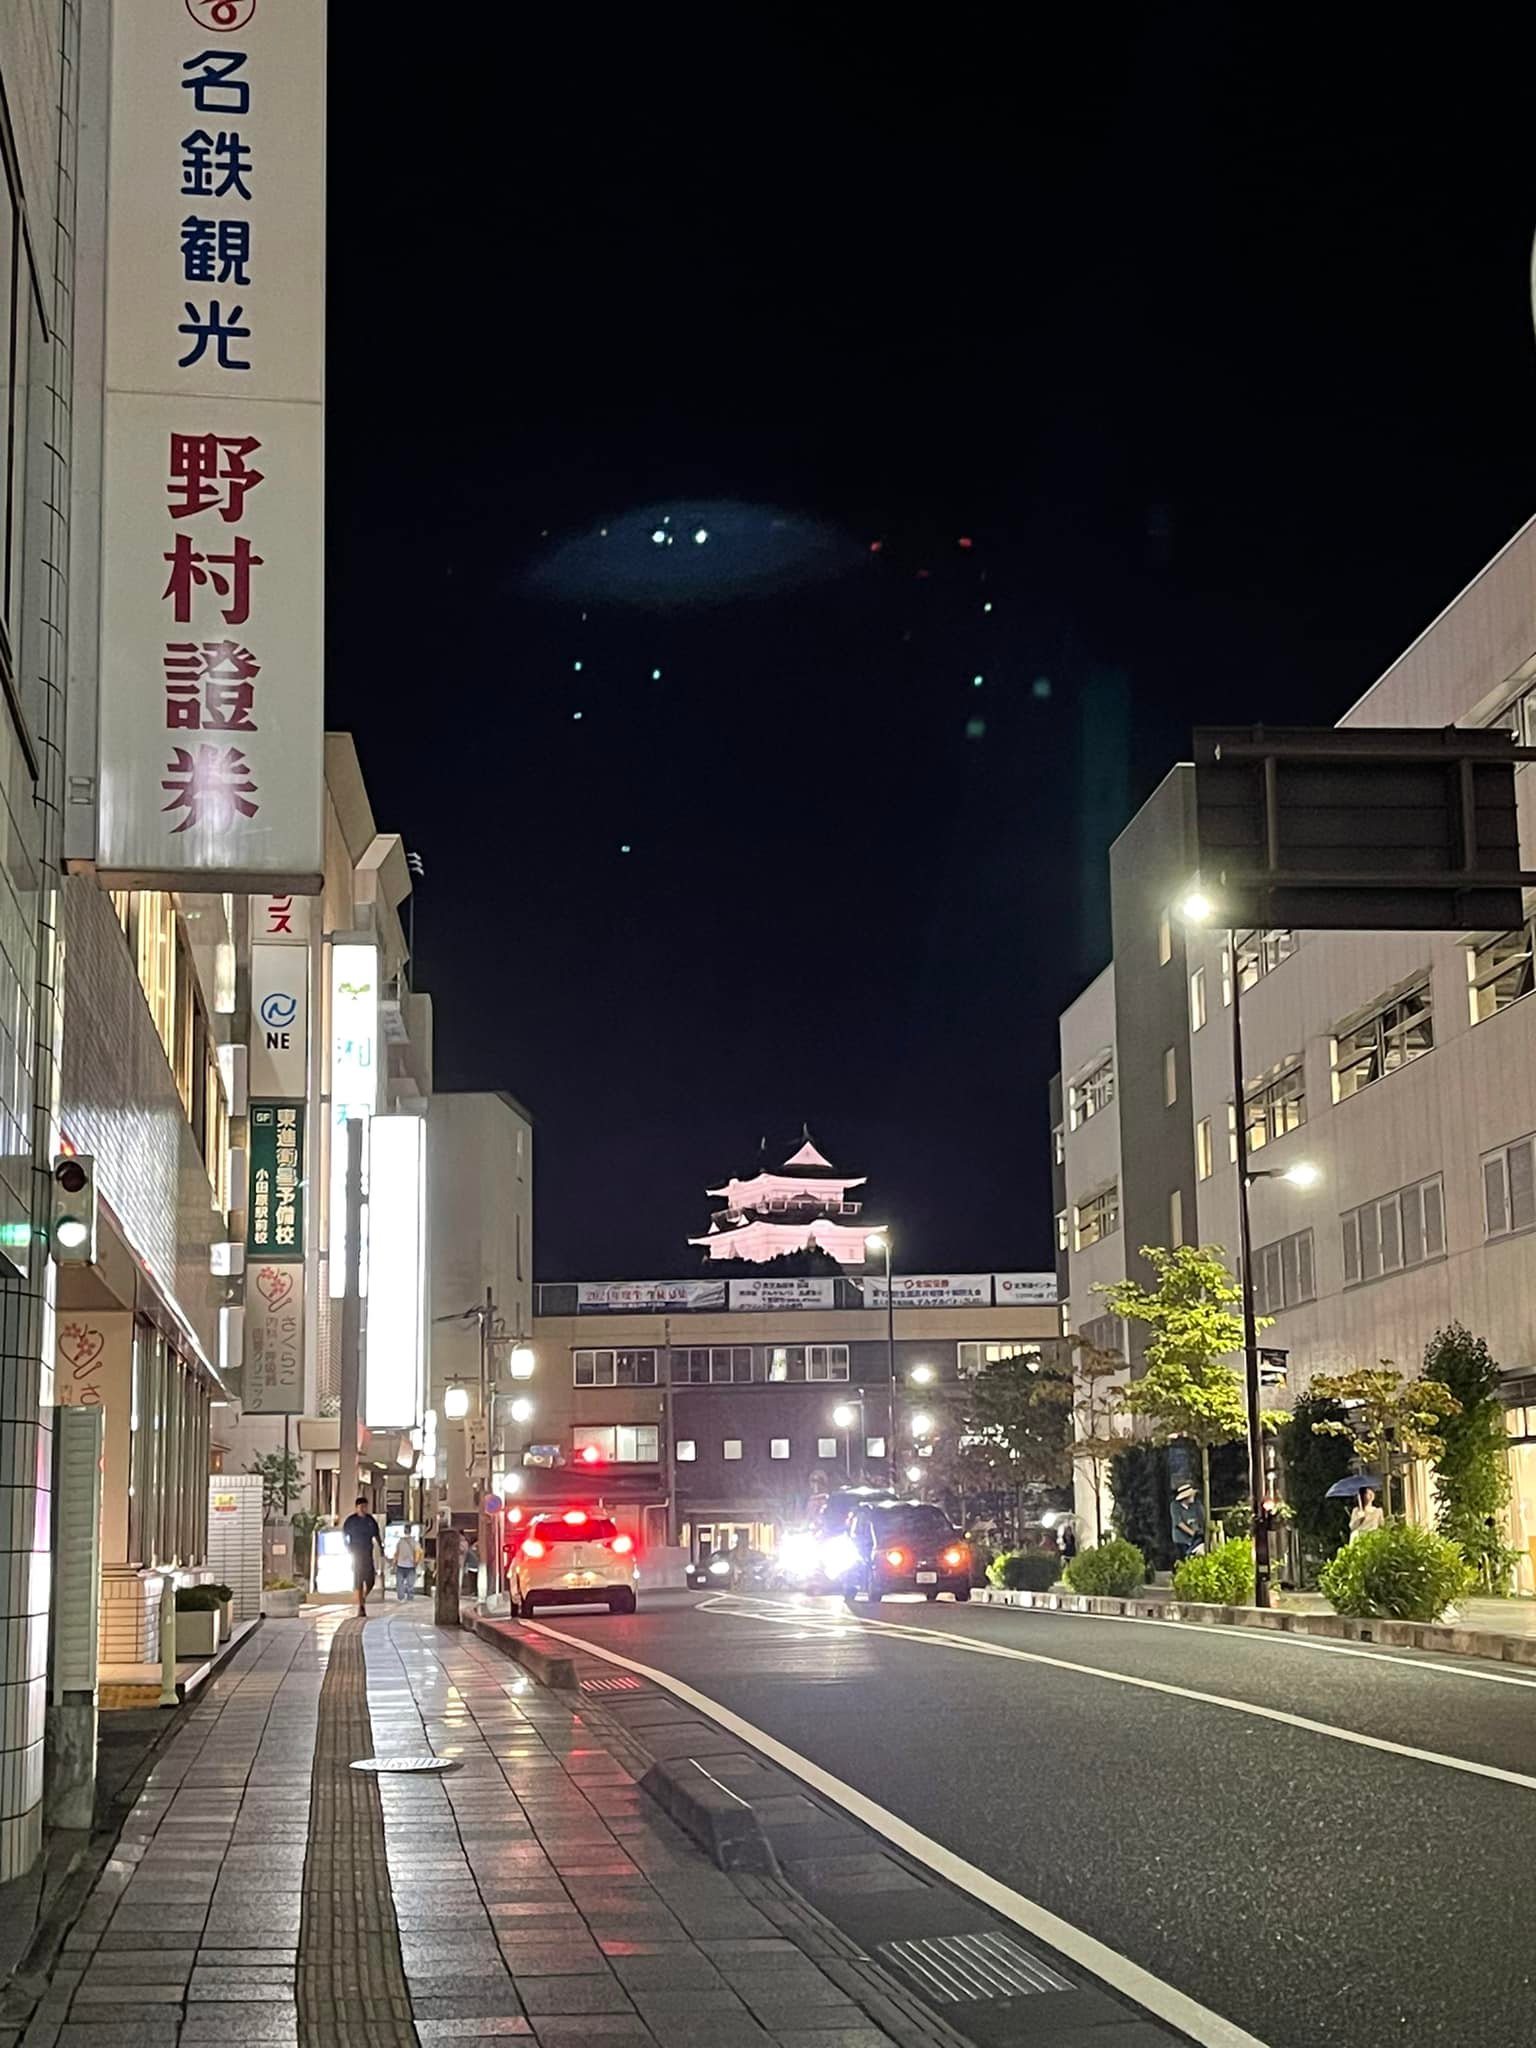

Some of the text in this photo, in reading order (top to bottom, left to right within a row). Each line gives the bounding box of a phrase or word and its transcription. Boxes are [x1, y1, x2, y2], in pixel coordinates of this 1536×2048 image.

[178, 50, 253, 370] 名鉄観光
[267, 1032, 290, 1049] NE
[255, 1168, 269, 1244] 小田原駅前校
[276, 1108, 298, 1245] 東進衛星予備校
[280, 1316, 297, 1386] さくらこ
